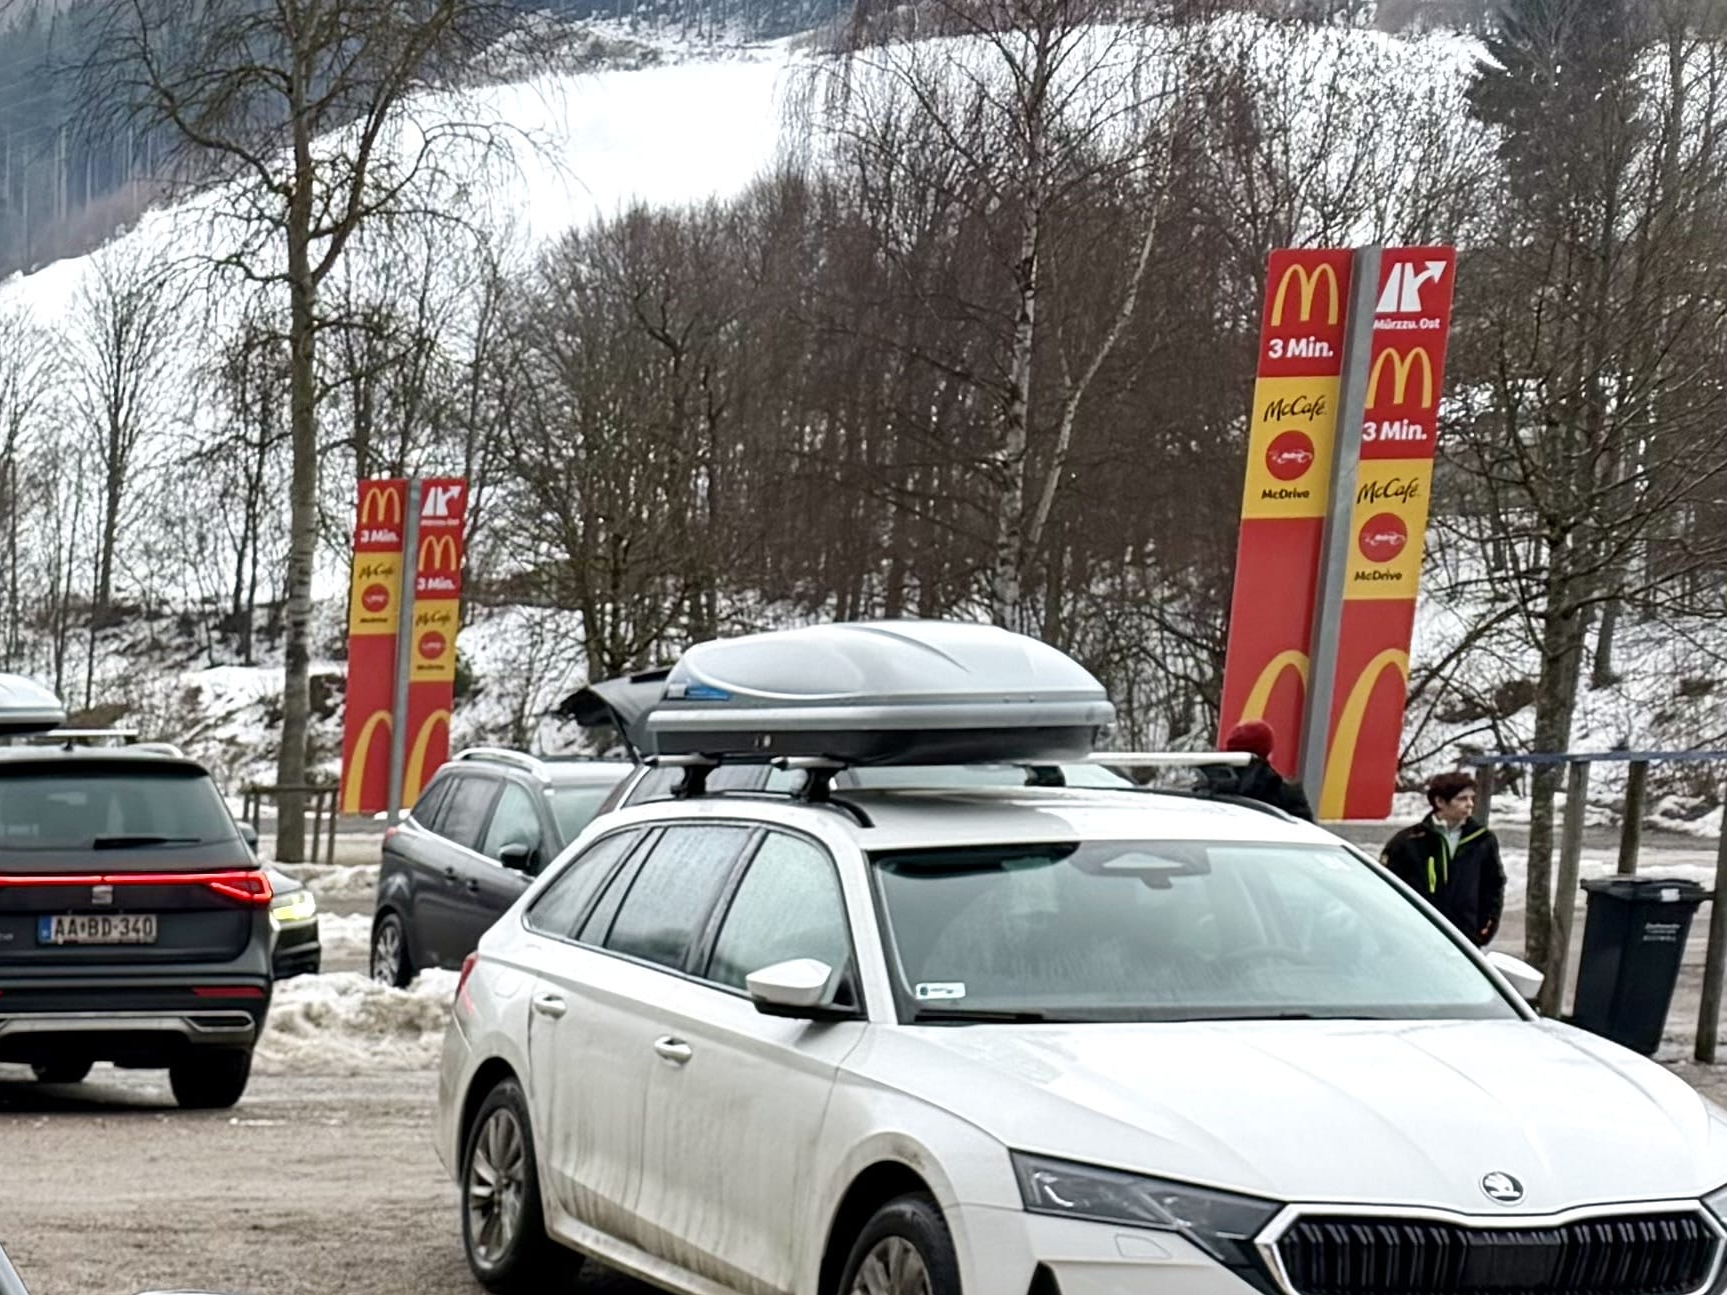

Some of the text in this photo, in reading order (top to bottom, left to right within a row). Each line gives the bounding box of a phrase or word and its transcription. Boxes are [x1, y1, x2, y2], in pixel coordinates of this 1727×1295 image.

[1420, 318, 1440, 329] Ost
[1268, 336, 1334, 358] 3 Min.
[1362, 419, 1427, 441] 3 Min.
[1261, 488, 1310, 500] McDrive
[360, 530, 370, 543] 3
[1354, 570, 1402, 582] McDrive
[416, 577, 426, 591] 3
